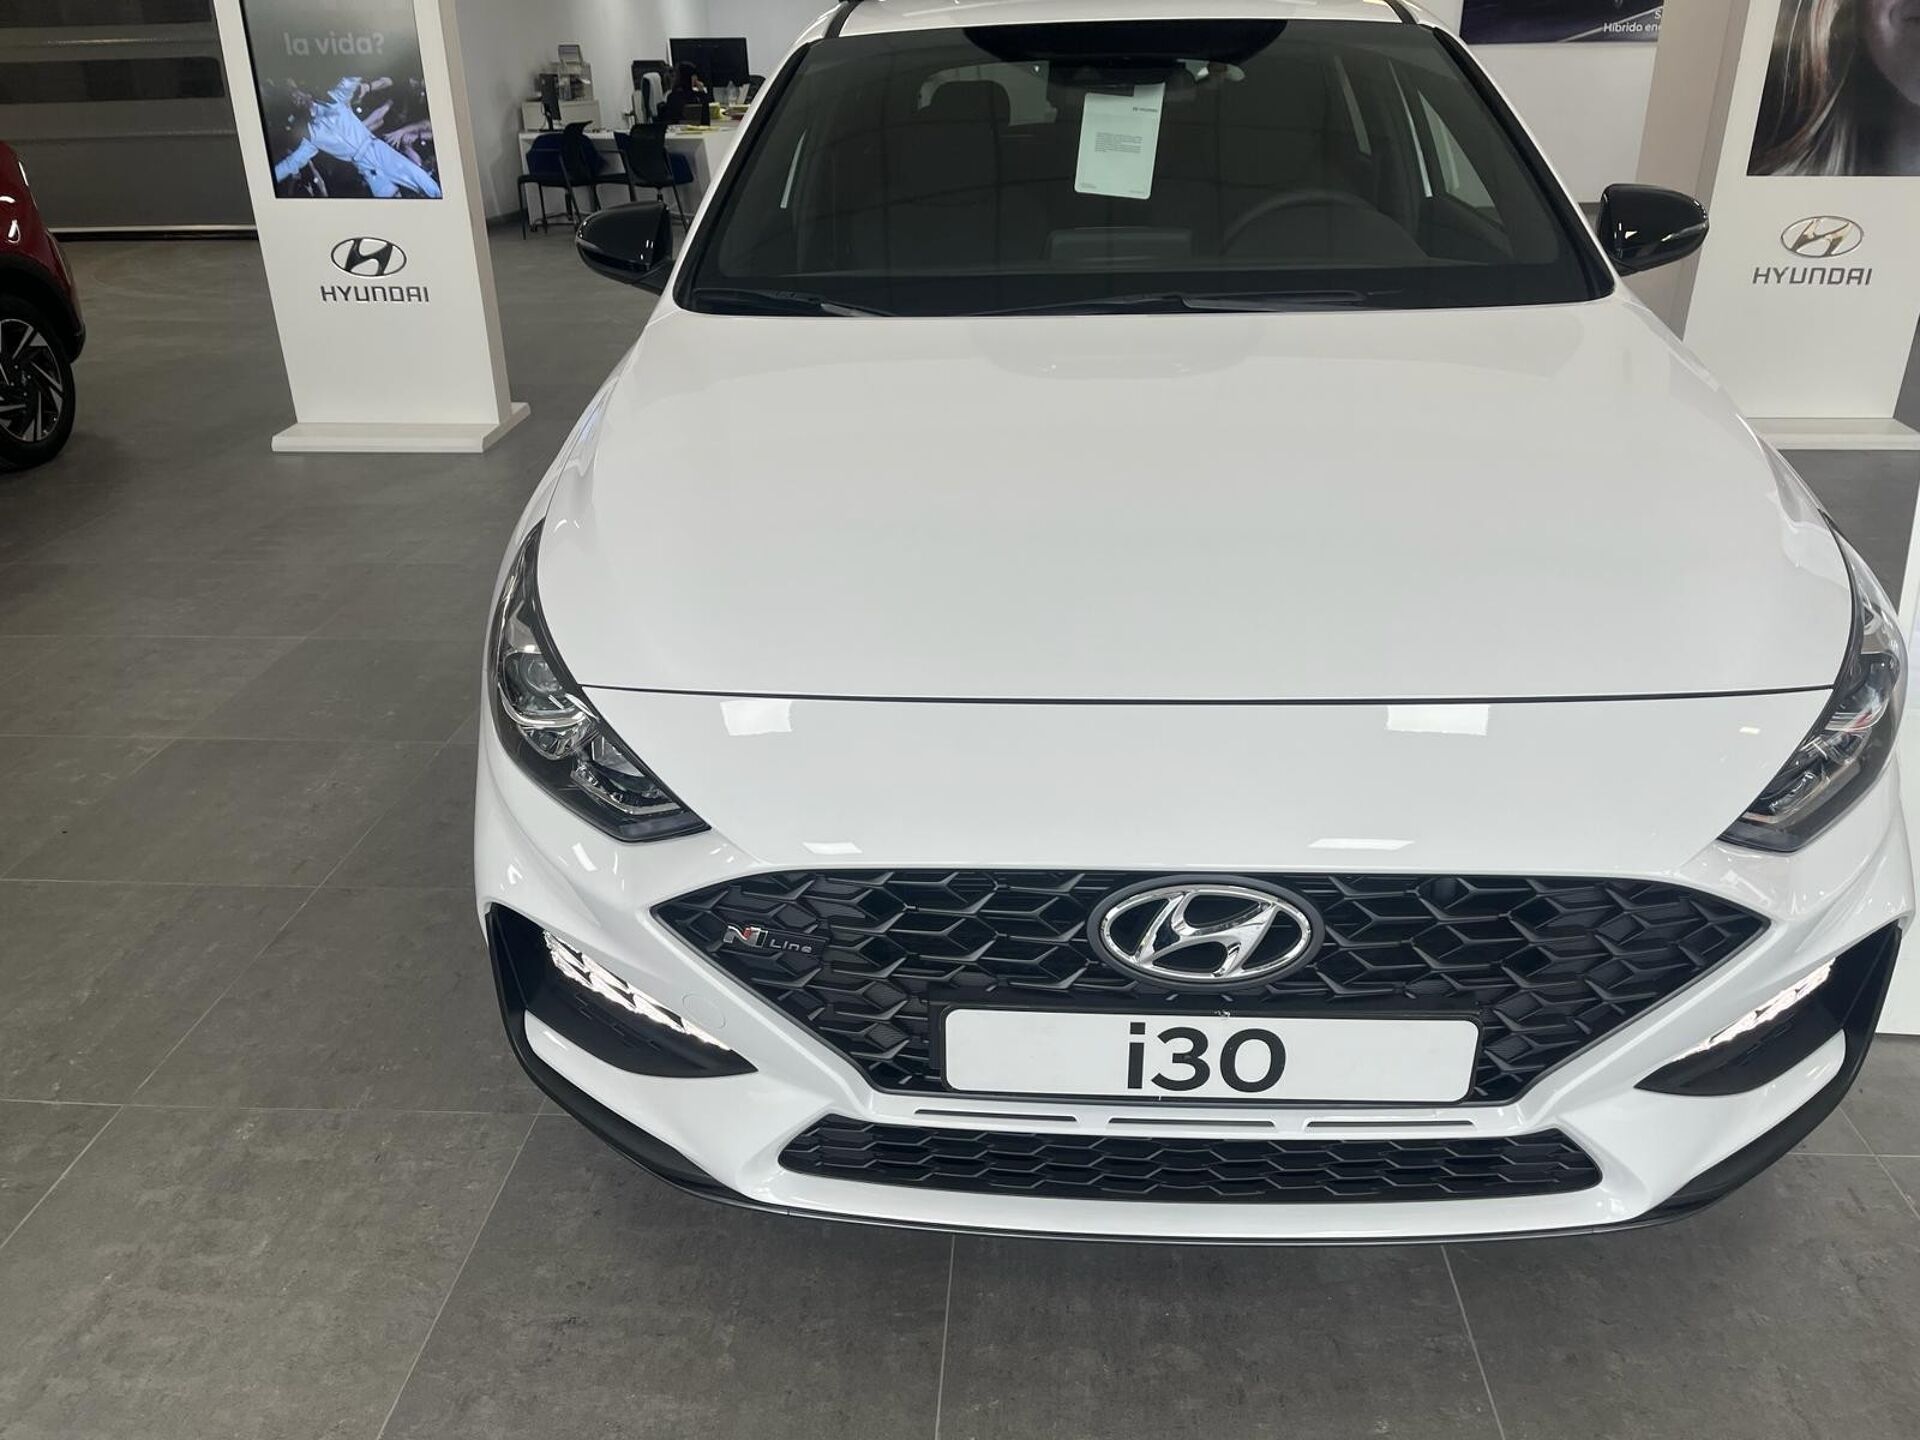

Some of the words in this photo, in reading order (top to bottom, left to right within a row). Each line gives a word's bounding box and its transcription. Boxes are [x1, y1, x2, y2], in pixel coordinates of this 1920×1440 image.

[283, 31, 309, 56] la
[315, 30, 385, 56] vida?
[1752, 266, 1873, 286] HYUNDAI
[320, 285, 430, 303] HYUNDAI
[769, 938, 813, 954] Line
[1127, 1021, 1287, 1094] i30
